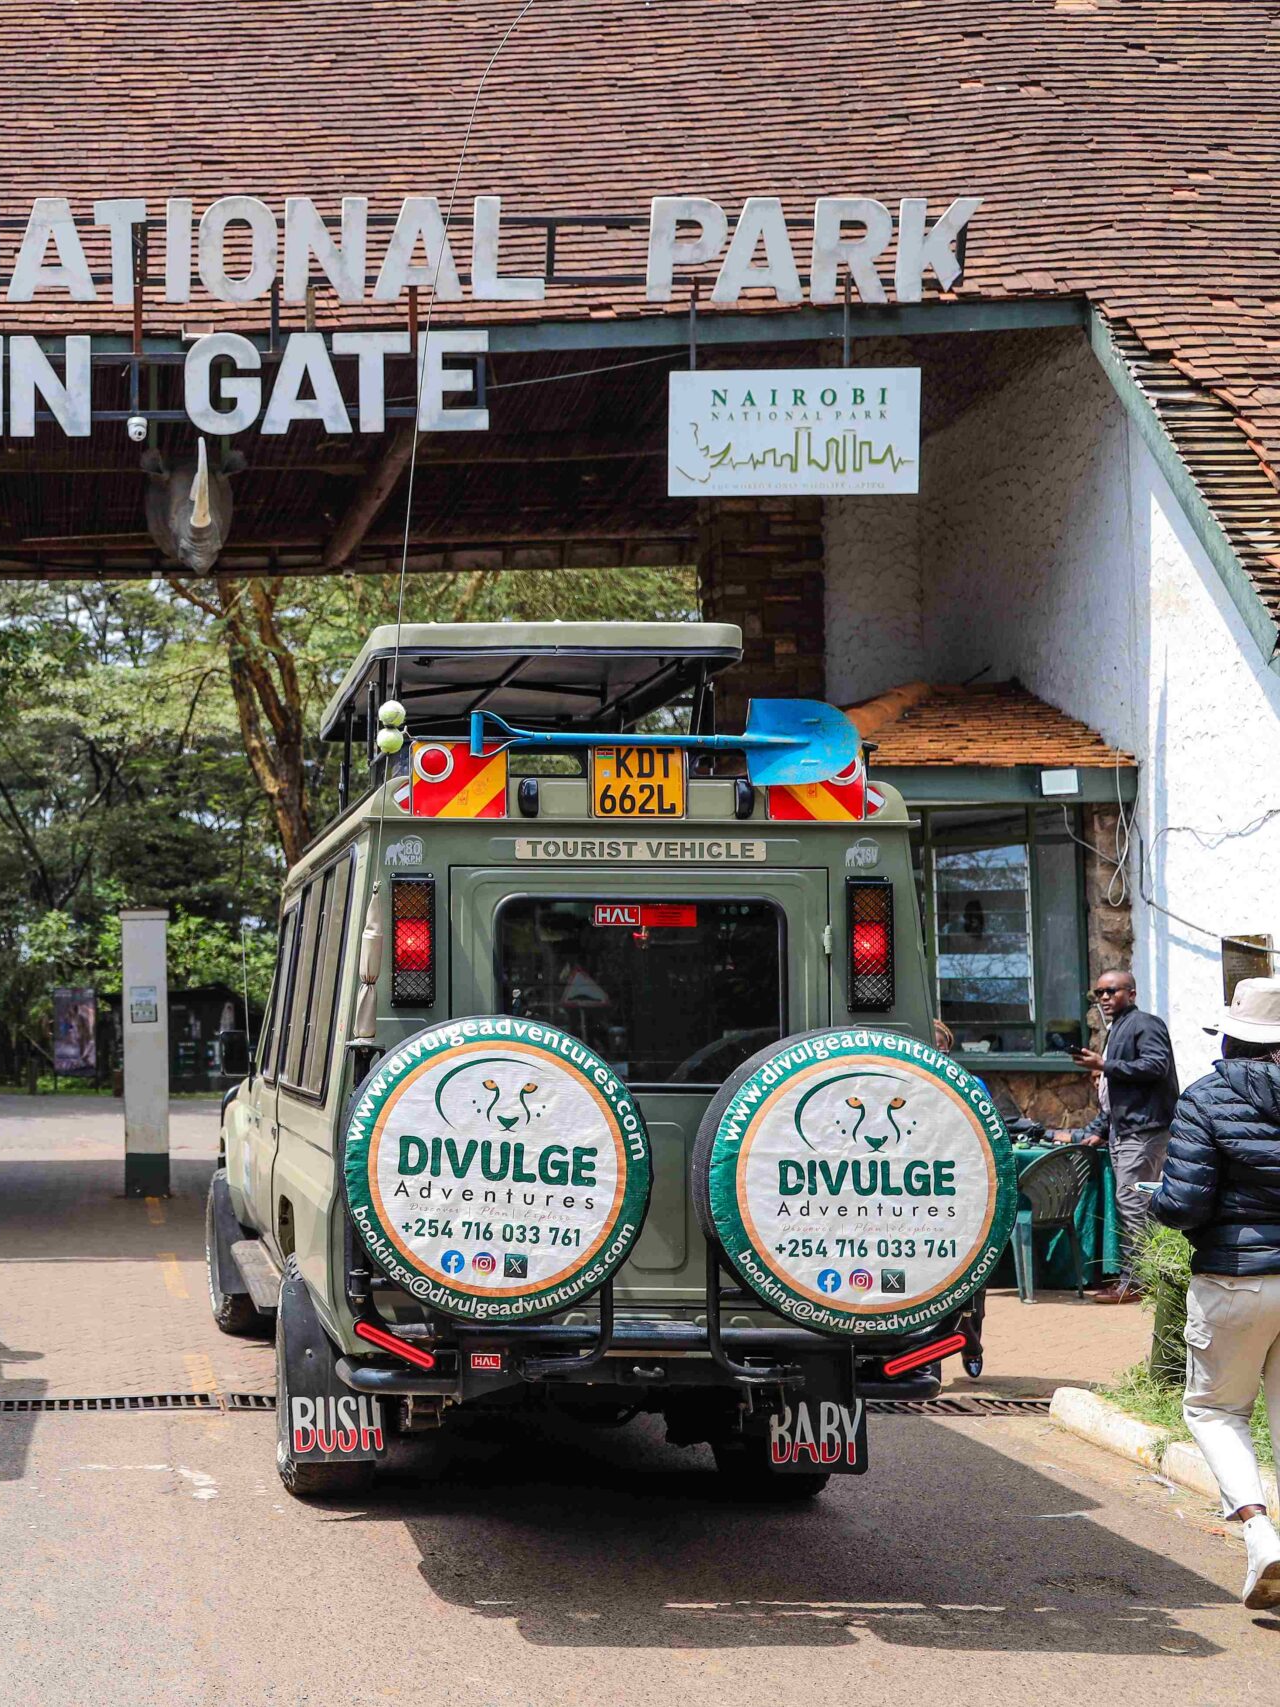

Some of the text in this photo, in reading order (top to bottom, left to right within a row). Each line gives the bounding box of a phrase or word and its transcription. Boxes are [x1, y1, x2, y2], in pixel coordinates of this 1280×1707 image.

[646, 196, 983, 305] PARK
[184, 330, 490, 437] GATE
[711, 387, 888, 407] NAIROBI
[711, 409, 888, 421] NATIONAL PARK
[615, 748, 675, 778] KDT
[599, 784, 676, 814] 662L
[405, 840, 421, 855] 80
[526, 840, 755, 860] TOURIST VEHICLE
[347, 1019, 645, 1161] www.divulgeadventures.com
[724, 1030, 1004, 1141] www.divulgeadventures.com
[397, 1135, 599, 1187] DIVULGE
[778, 1159, 956, 1197] DIVULGE
[394, 1180, 594, 1210] Adventures
[777, 1200, 956, 1217] Adventures
[401, 1218, 581, 1247] +254 716 033 761
[775, 1239, 956, 1258] +254 716 033 761
[353, 1205, 636, 1319] bookings@divulgeadvuntures.com
[737, 1246, 999, 1334] booking@divulgeadvuntures.com
[291, 1395, 384, 1453] BUSH
[769, 1398, 863, 1466] BABY
